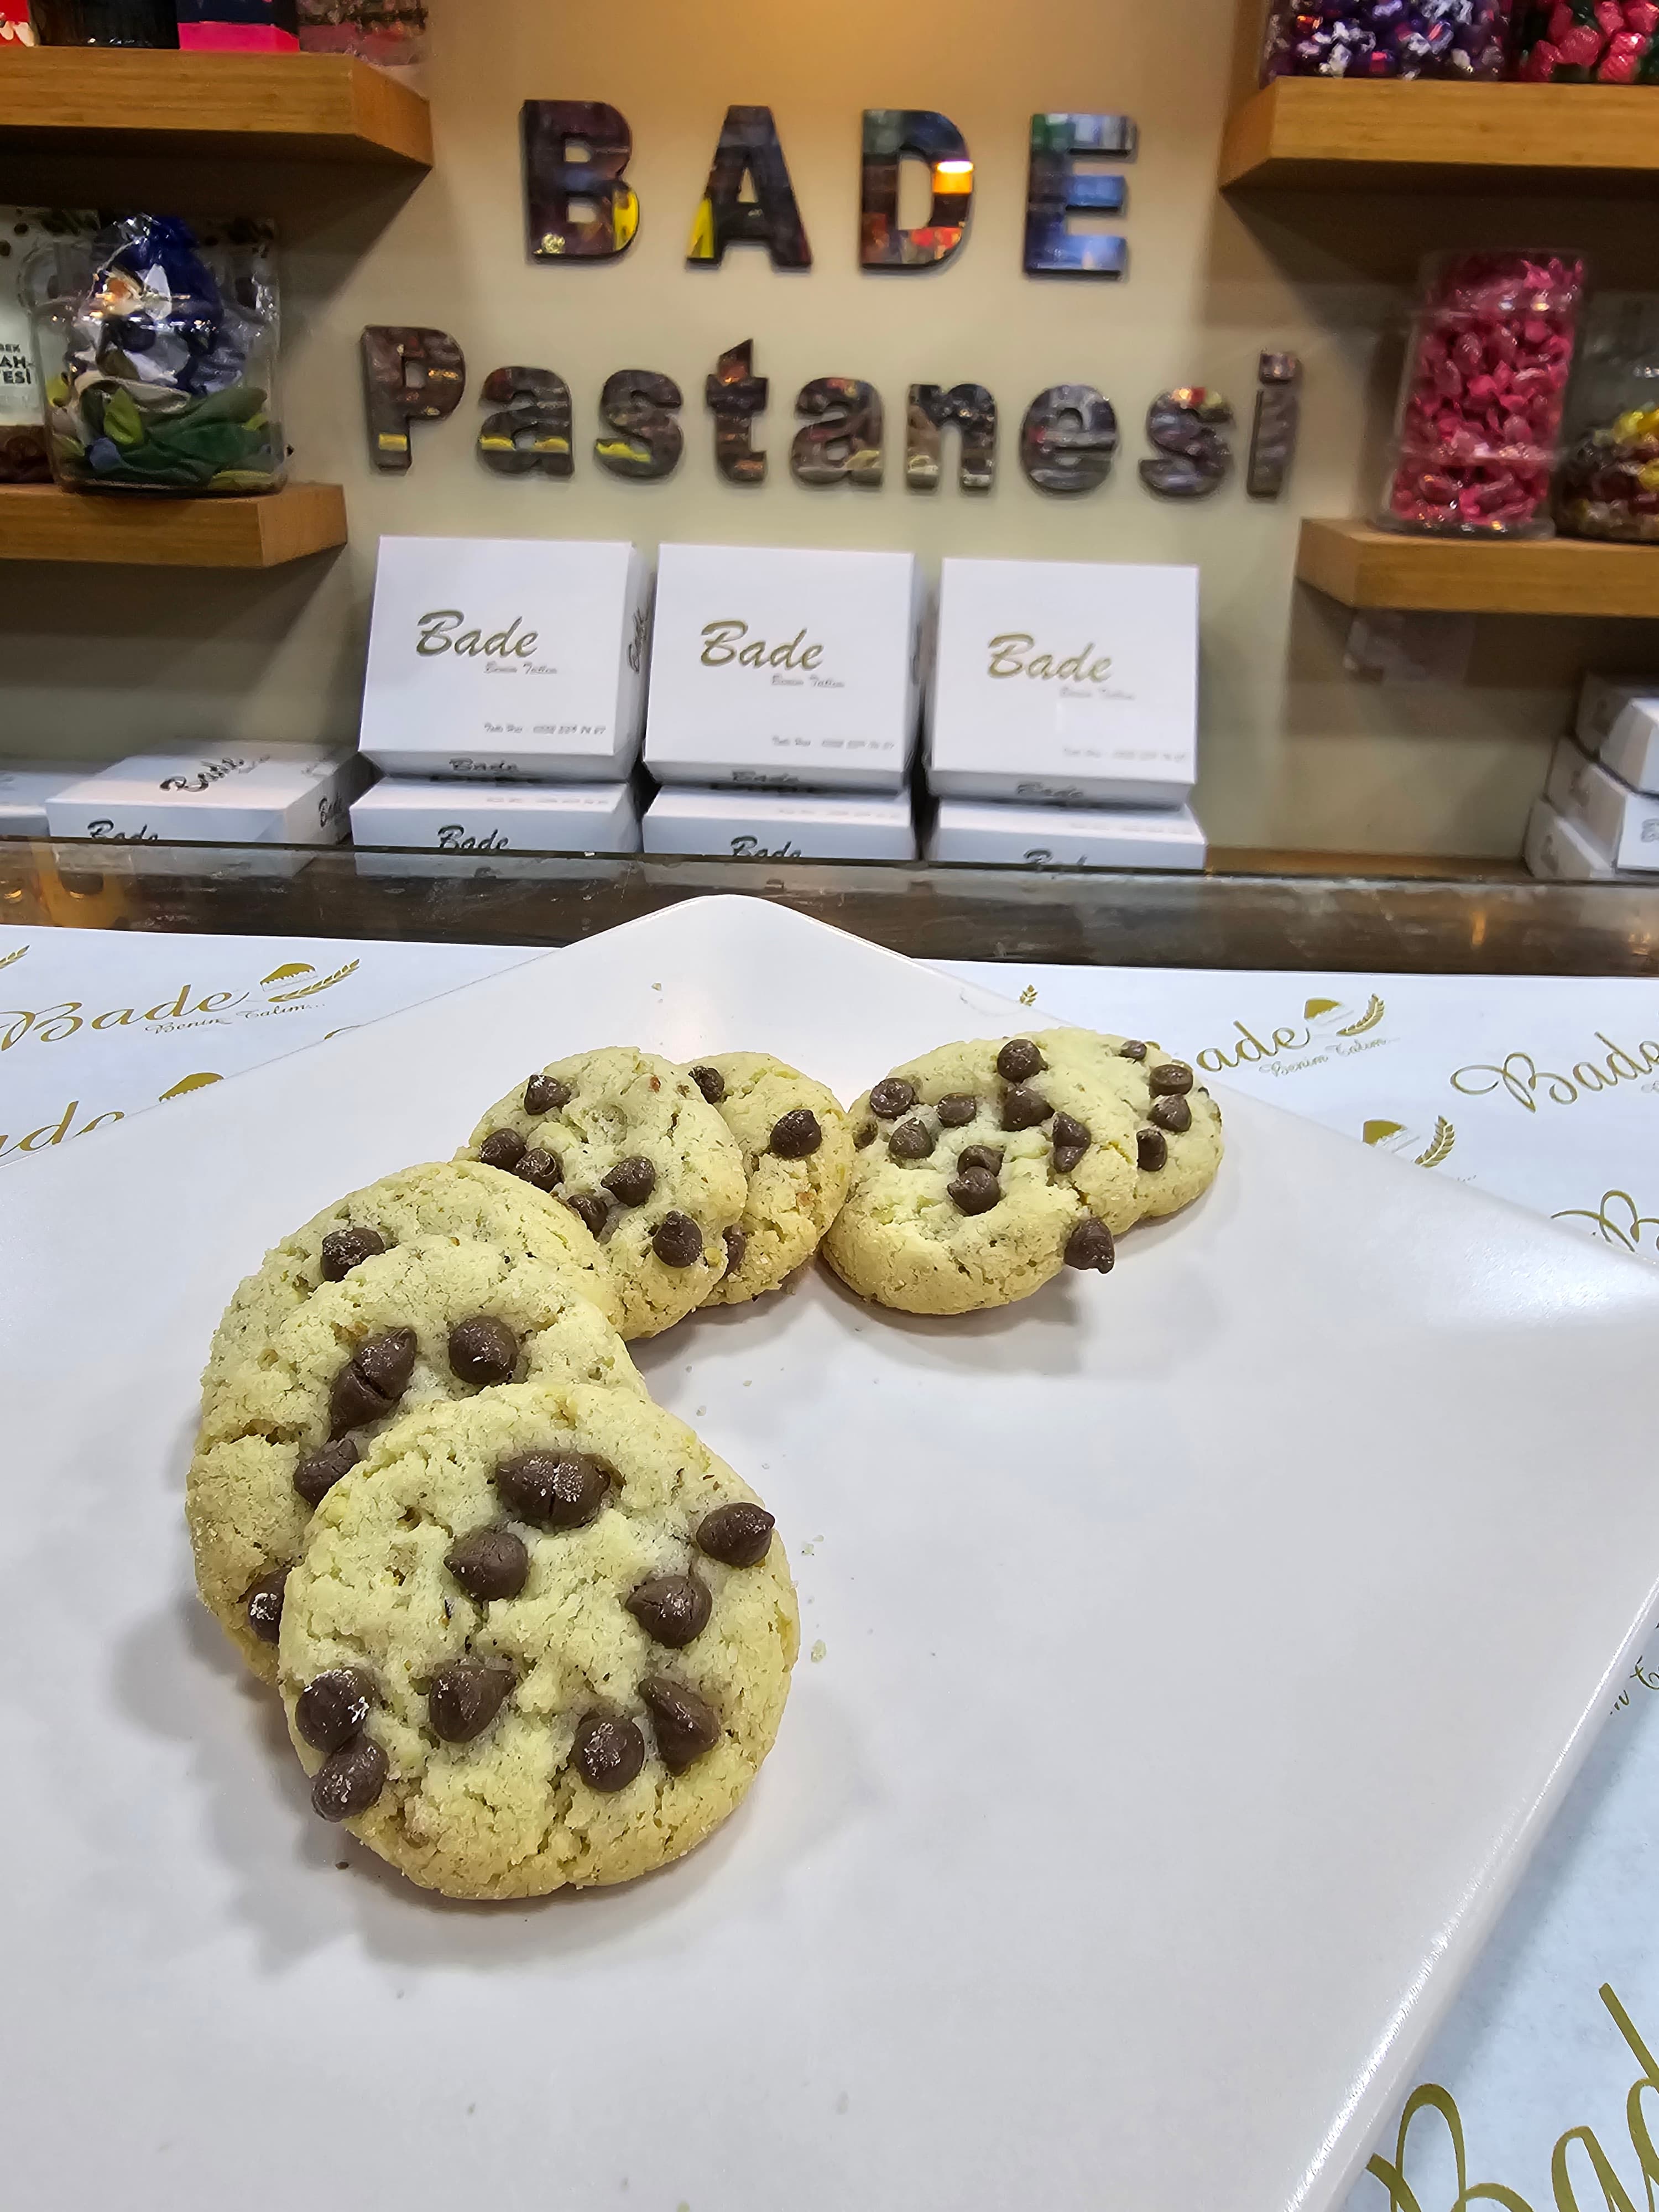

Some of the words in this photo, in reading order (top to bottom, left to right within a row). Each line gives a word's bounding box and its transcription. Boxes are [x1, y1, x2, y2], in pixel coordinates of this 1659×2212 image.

[519, 98, 1138, 280] BADE
[359, 325, 1301, 498] Pastanesi
[415, 610, 539, 658] Bade
[700, 620, 824, 670] Bade
[987, 633, 1113, 682] Bade
[437, 823, 509, 849] Bade
[0, 984, 250, 1051] Bade
[1196, 1020, 1310, 1072] ade
[1450, 1031, 1659, 1114] Bade
